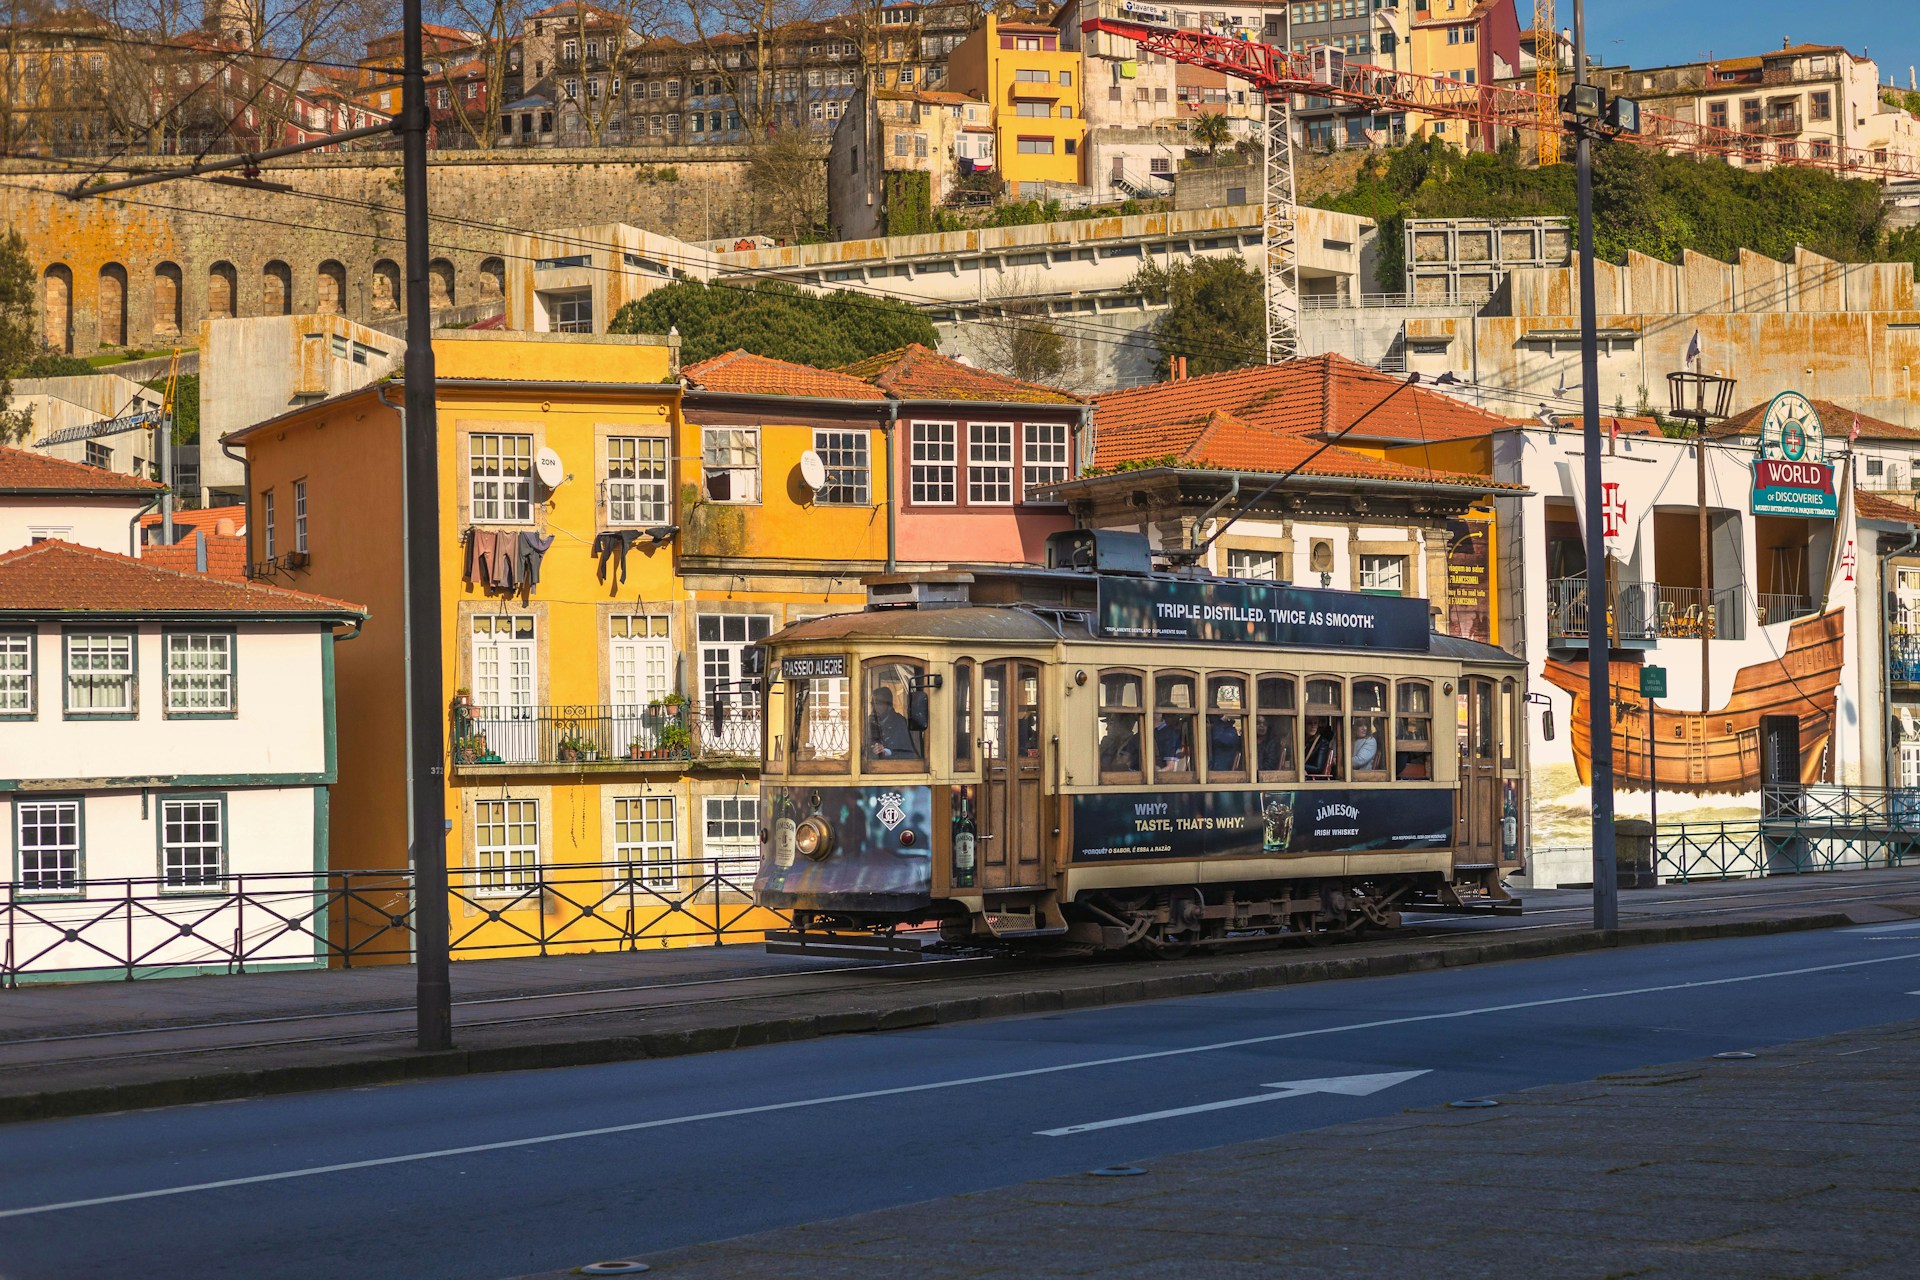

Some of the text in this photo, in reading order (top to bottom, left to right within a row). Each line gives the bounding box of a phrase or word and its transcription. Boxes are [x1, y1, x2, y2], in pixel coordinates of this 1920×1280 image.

[1133, 3, 1157, 13] tavares
[1768, 463, 1820, 484] WORLD
[1776, 491, 1824, 504] DISCOVERIES
[1156, 603, 1200, 619] TRIPLE
[1204, 606, 1266, 622] DISTILLED.
[1269, 608, 1306, 624] TWICE
[1308, 612, 1324, 626] AS
[750, 650, 758, 672] 1
[784, 660, 842, 676] PASSEIO ALEGRE
[1134, 803, 1168, 816] WHY?
[1316, 804, 1358, 821] JAMESON
[1135, 819, 1174, 832] TASTE,
[1176, 818, 1214, 830] THAT'S
